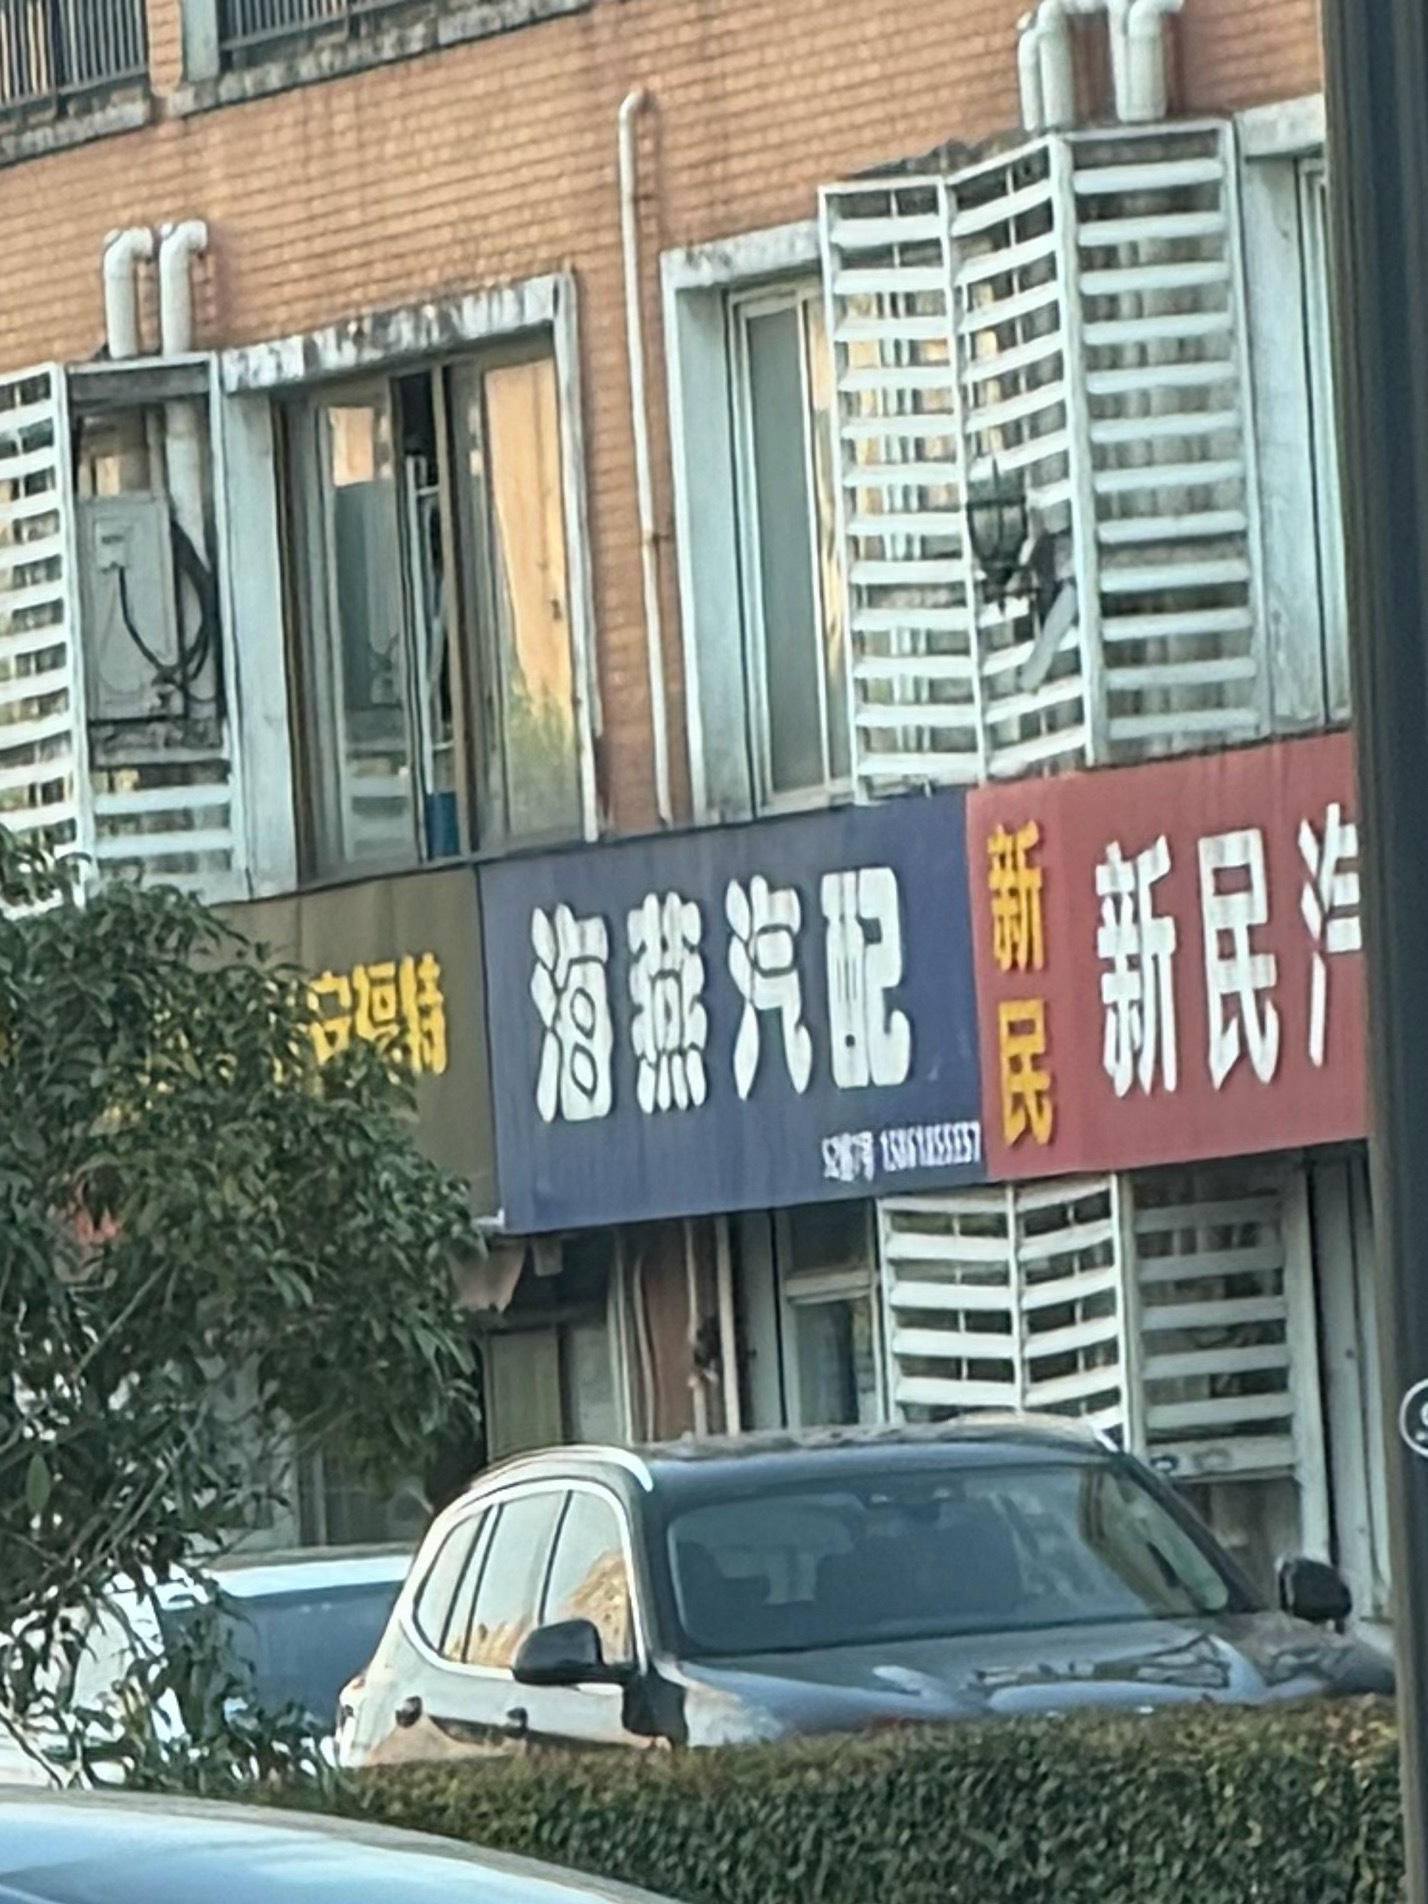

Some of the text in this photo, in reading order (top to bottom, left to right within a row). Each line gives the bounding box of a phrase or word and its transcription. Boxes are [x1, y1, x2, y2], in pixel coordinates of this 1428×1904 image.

[530, 866, 912, 1124] 海燕汽配
[986, 819, 1054, 1147] 新民
